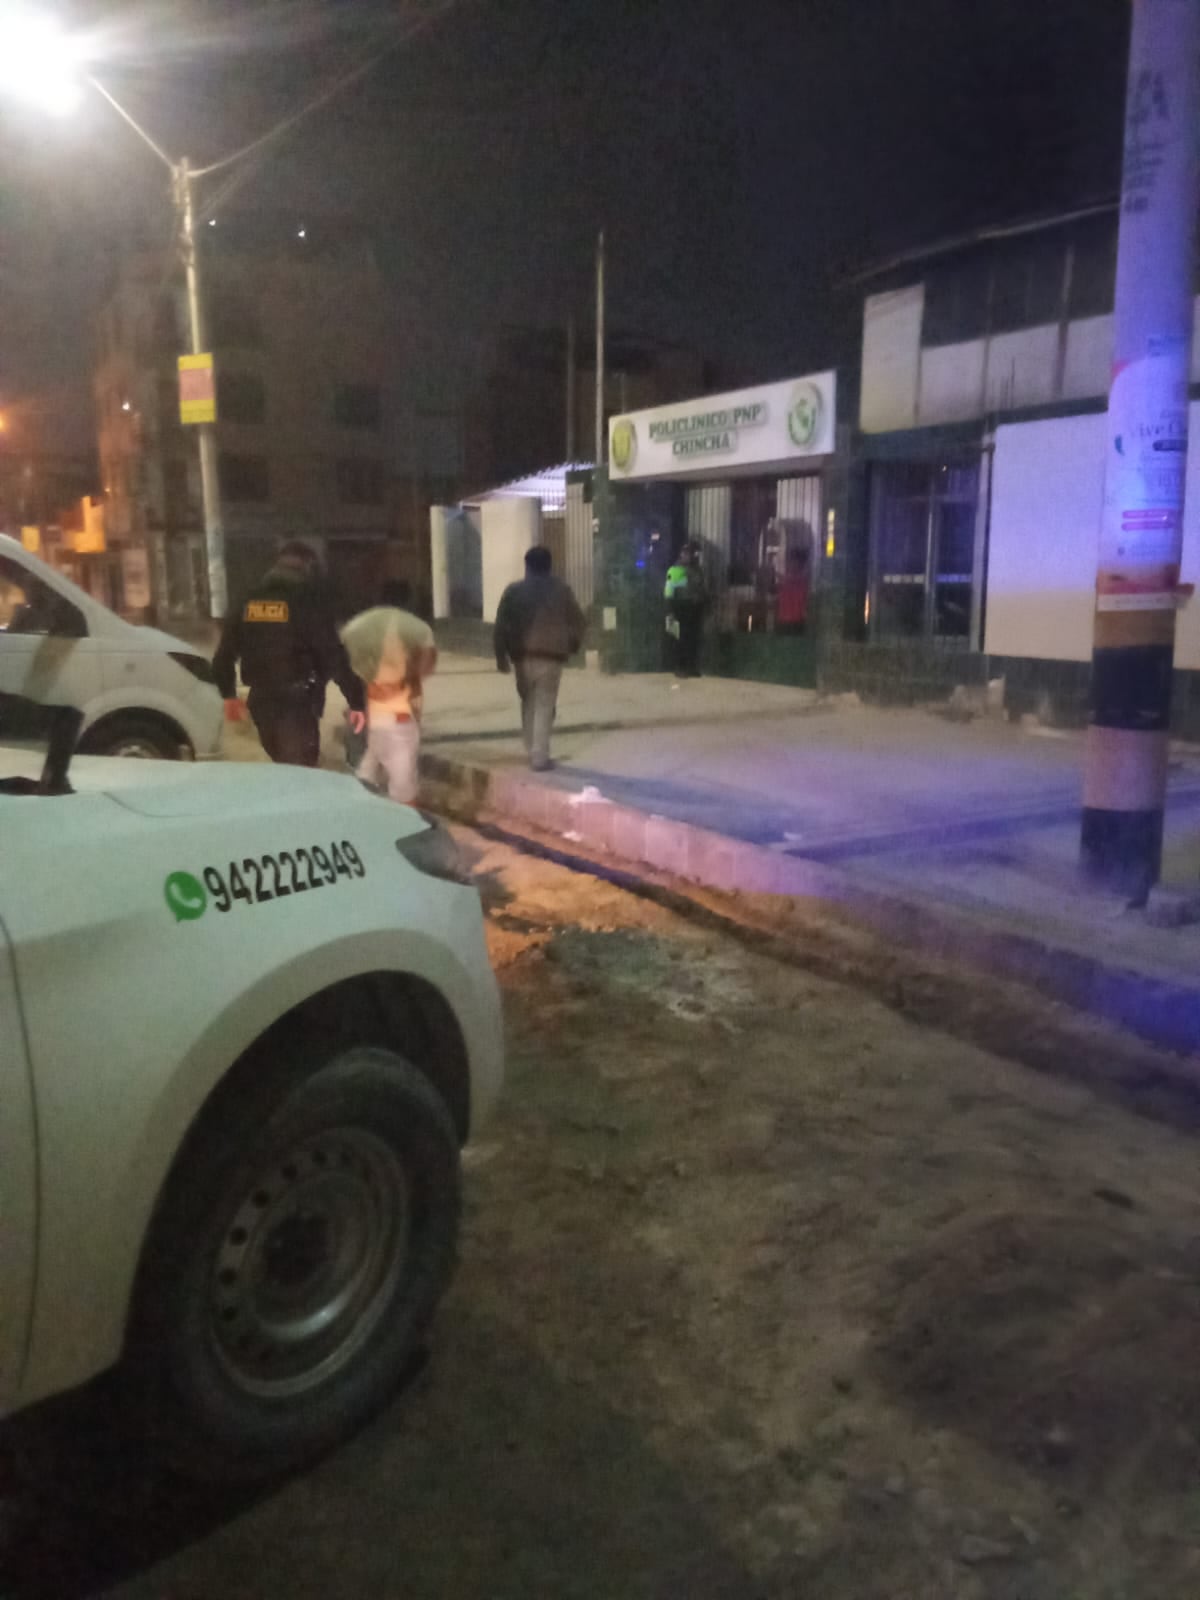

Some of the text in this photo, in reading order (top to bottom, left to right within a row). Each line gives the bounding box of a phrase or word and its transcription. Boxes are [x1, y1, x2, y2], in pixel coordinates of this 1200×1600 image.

[733, 404, 761, 424] PNP
[672, 434, 730, 455] CHINCHA
[203, 840, 366, 912] 942222949
